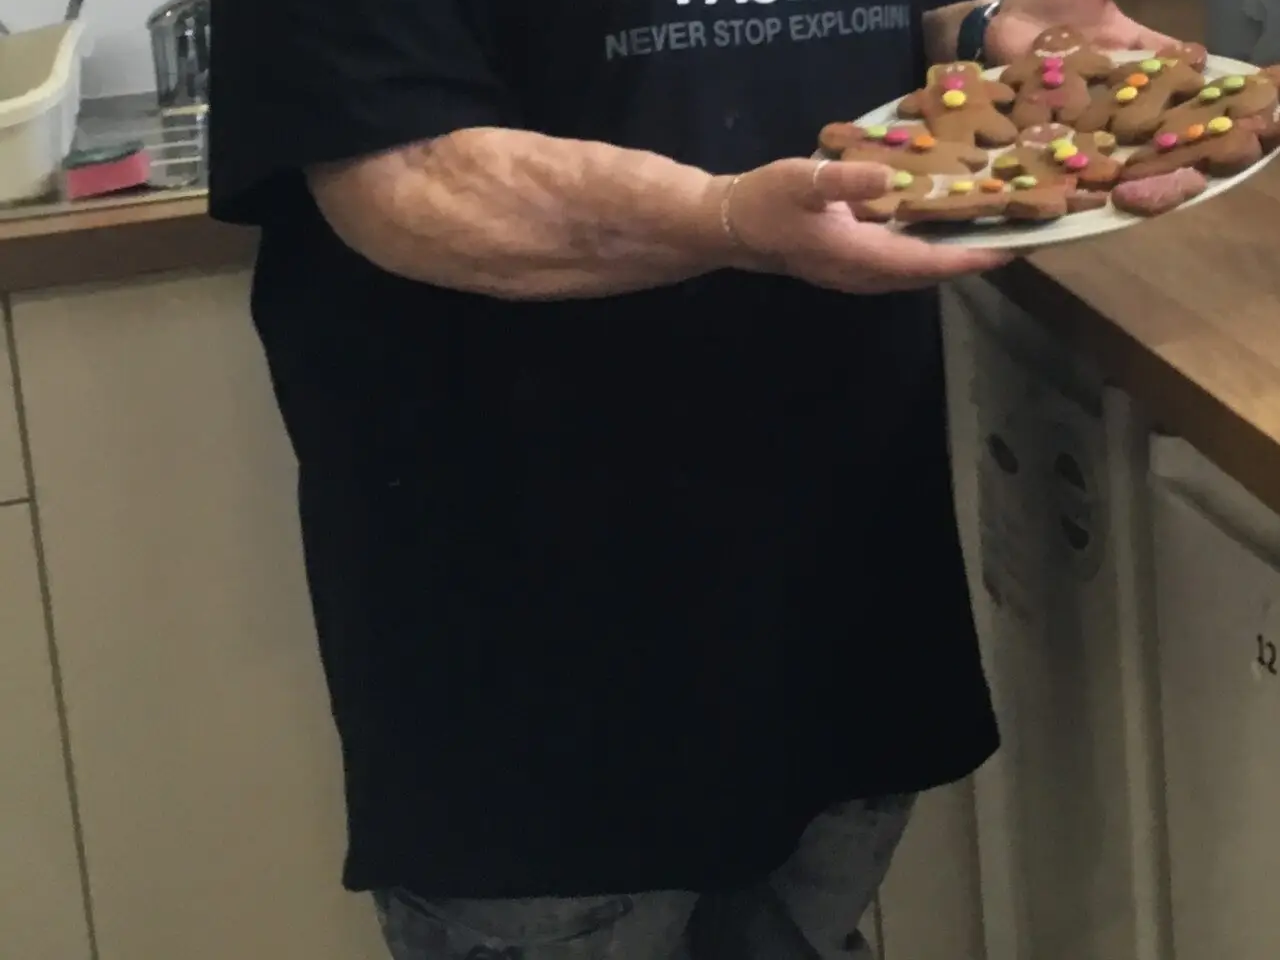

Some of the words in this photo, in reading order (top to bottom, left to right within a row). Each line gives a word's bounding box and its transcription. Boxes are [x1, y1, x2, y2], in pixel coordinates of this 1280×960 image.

[604, 20, 707, 61] NEVER
[713, 17, 782, 47] STOP
[1257, 634, 1277, 676] 12
